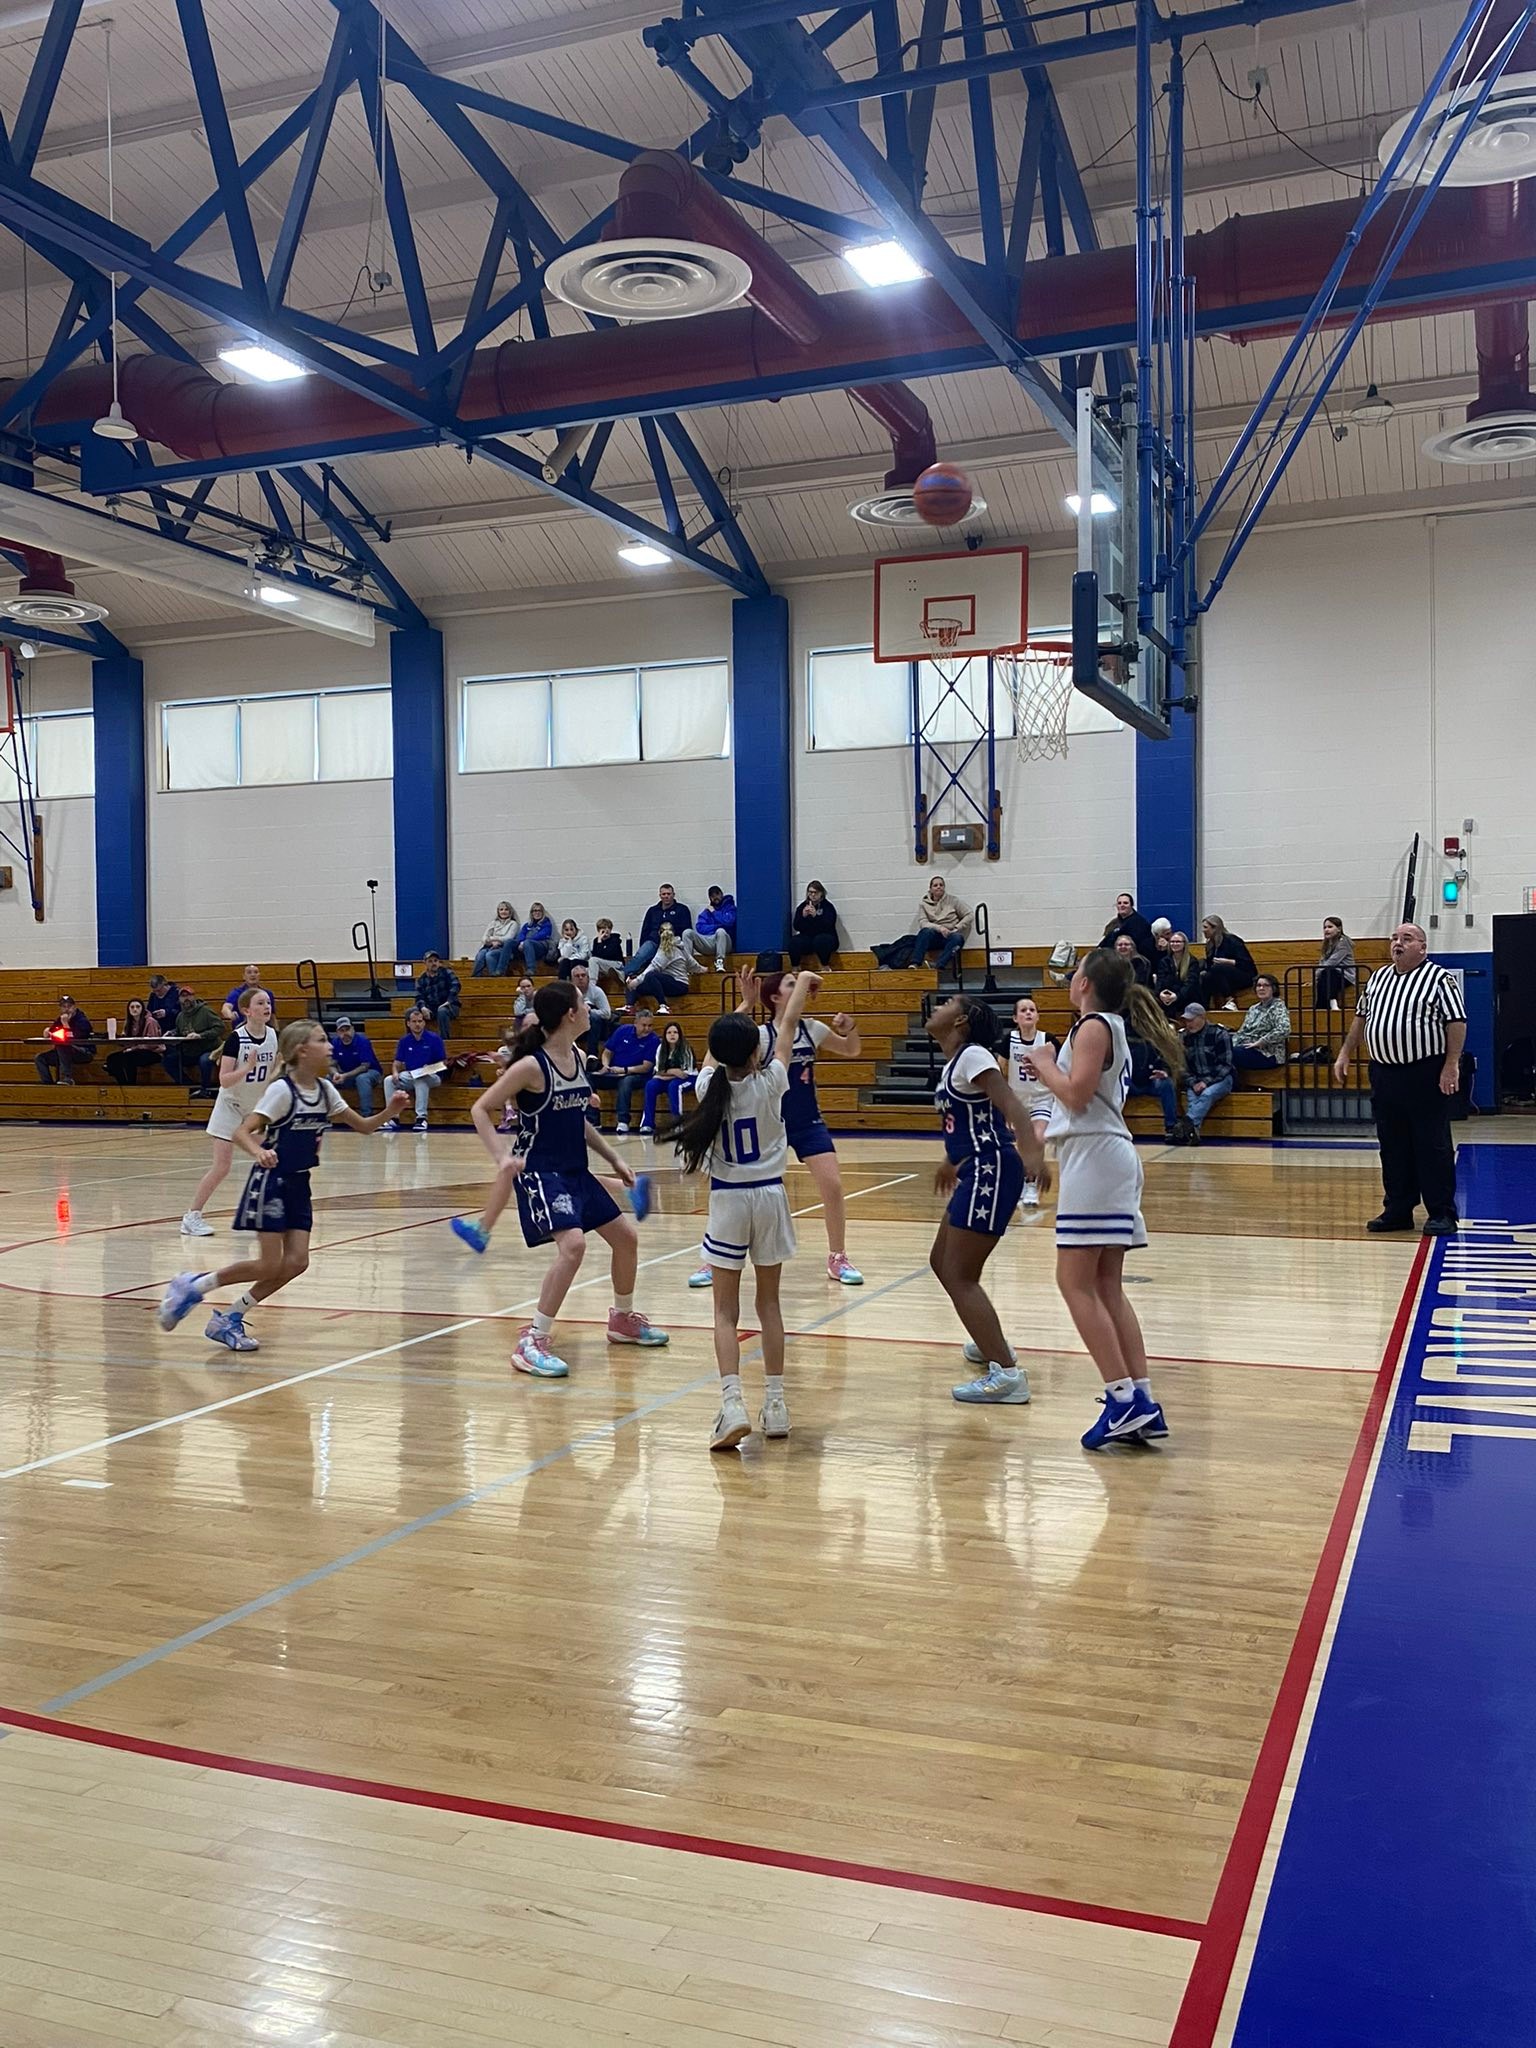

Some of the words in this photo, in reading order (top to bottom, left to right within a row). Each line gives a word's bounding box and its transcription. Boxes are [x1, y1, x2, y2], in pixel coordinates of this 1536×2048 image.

[244, 1052, 274, 1063] RKETS
[245, 1065, 268, 1083] 20
[552, 1093, 589, 1112] Bulldog
[721, 1117, 761, 1165] 10
